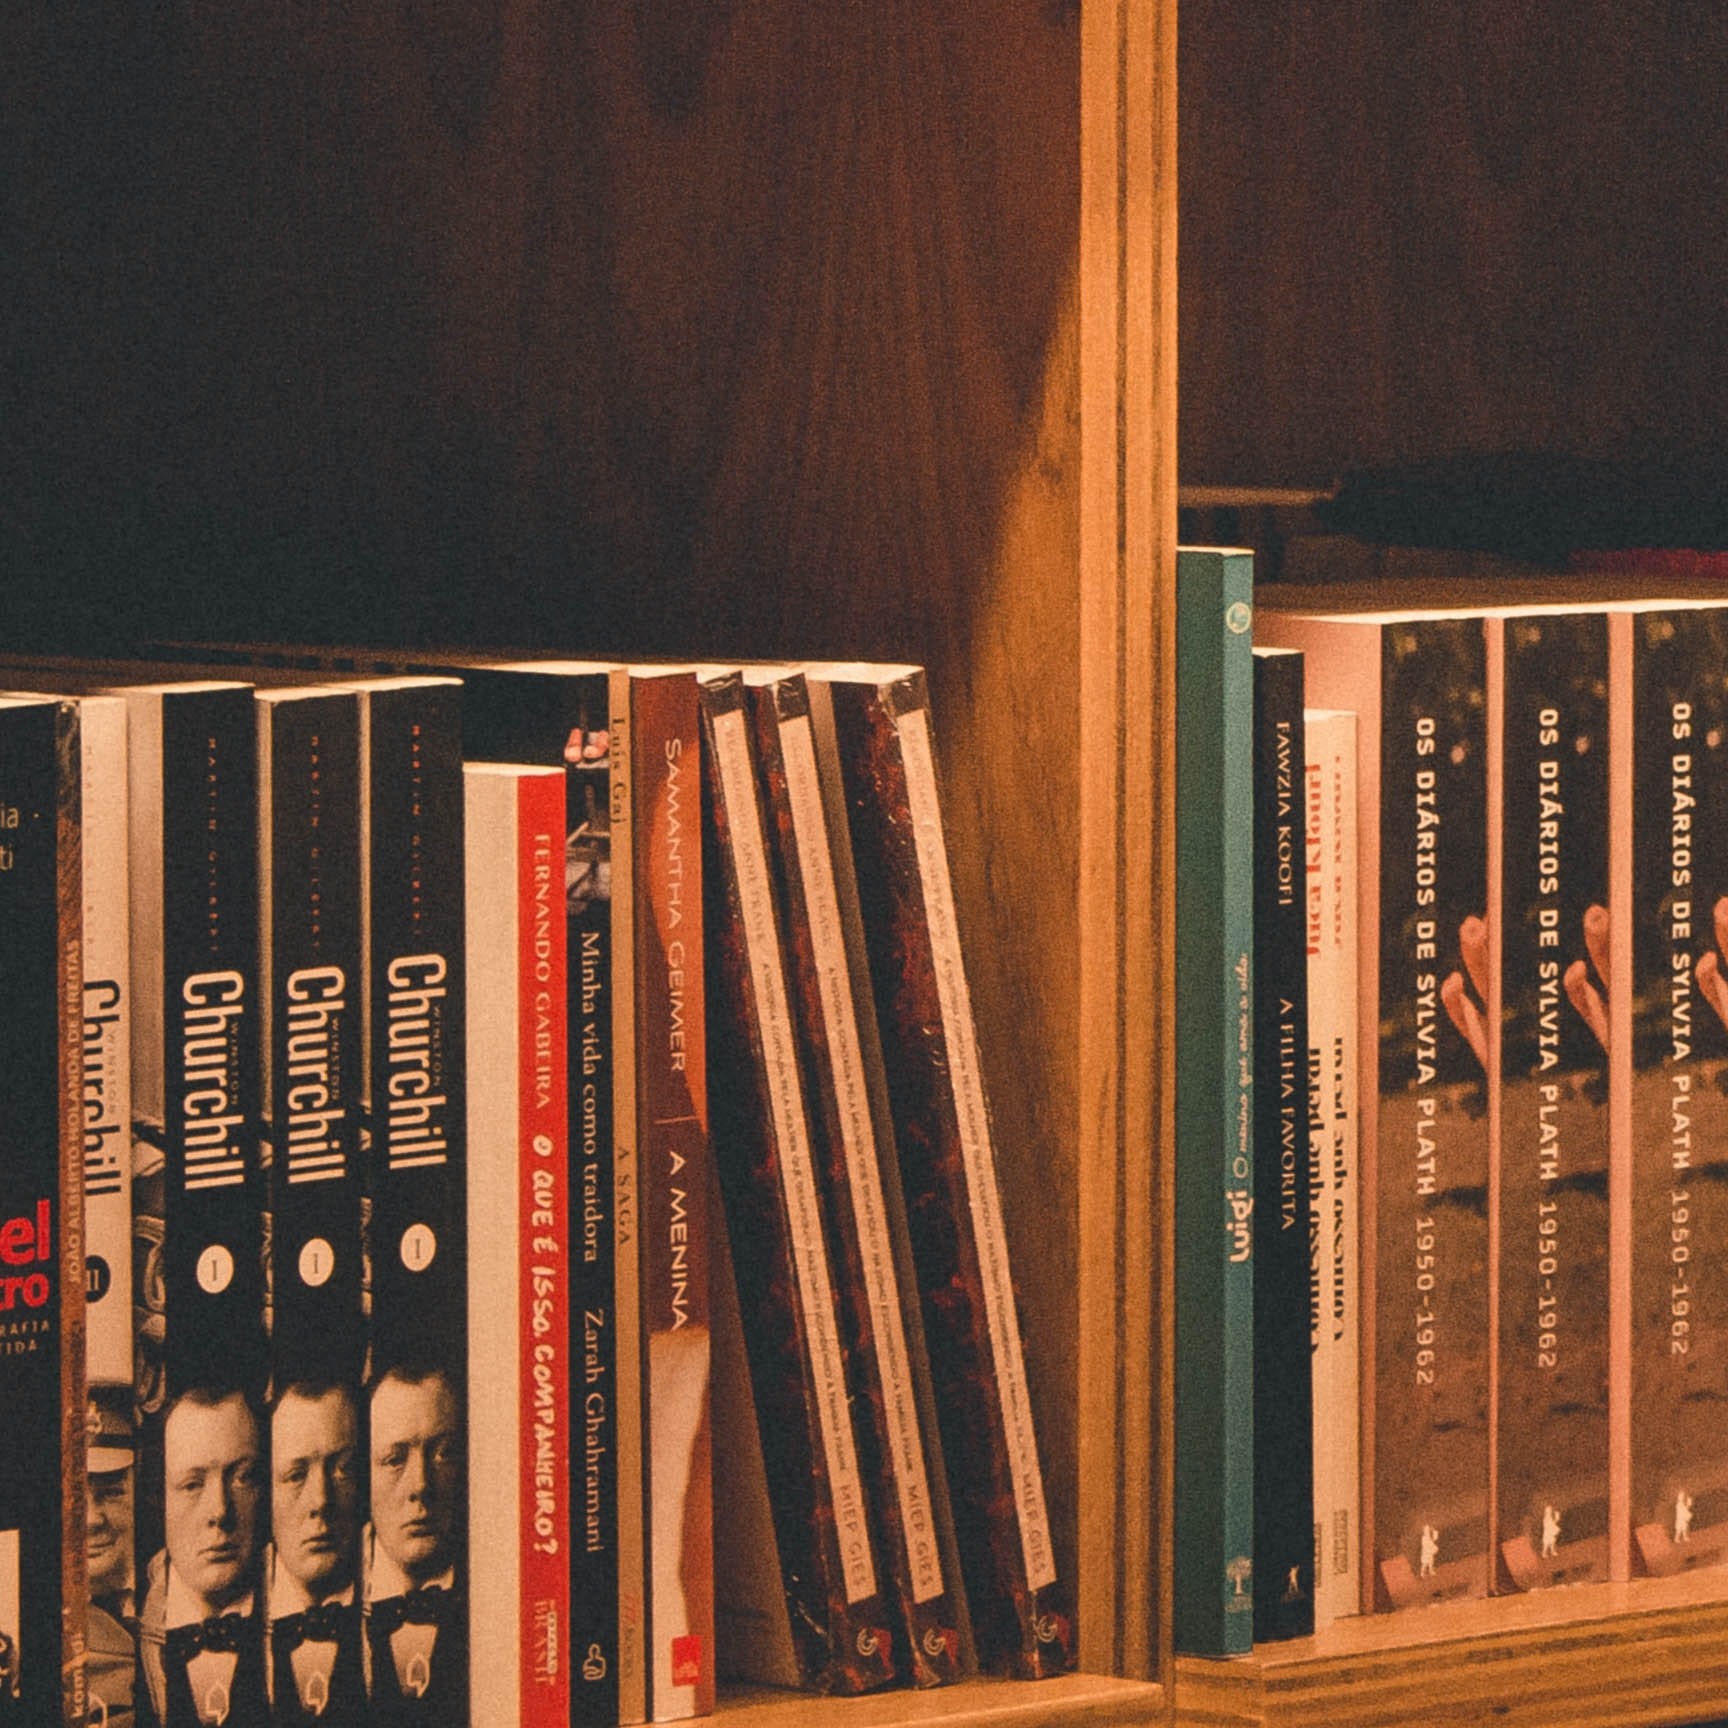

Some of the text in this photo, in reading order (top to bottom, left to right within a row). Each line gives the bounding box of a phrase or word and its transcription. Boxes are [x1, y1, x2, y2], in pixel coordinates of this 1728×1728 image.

[663, 739, 687, 1069] SAMANTHA GEIMER
[1277, 722, 1291, 904] FAWZIA KOOFI
[287, 966, 348, 1182] Churchill
[388, 954, 446, 1168] Churchill
[535, 834, 550, 1107] FERNANDO GABEIRA
[1416, 718, 1440, 1382] OS DIÁRIOS DE SYLVIA PLATH 1950-1962
[1538, 709, 1562, 1365] OS DIÁRIOS DE SYLVIA PLATH 1950-1962
[1671, 702, 1694, 1353] OS DIÁRIOS DE SYLVIA PLATH 1950-1962
[183, 971, 243, 1188] Churchill
[533, 1135, 551, 1154] O
[581, 932, 601, 1261] Minha vida como traidora
[1280, 998, 1294, 1228] A FILHA FAVORITA
[531, 1169, 553, 1225] QUE
[533, 1238, 556, 1252] É
[669, 1151, 688, 1330] A MENINA
[531, 1345, 556, 1553] COMPANHEIRO?
[585, 1309, 604, 1551] Zarah Ghahramani
